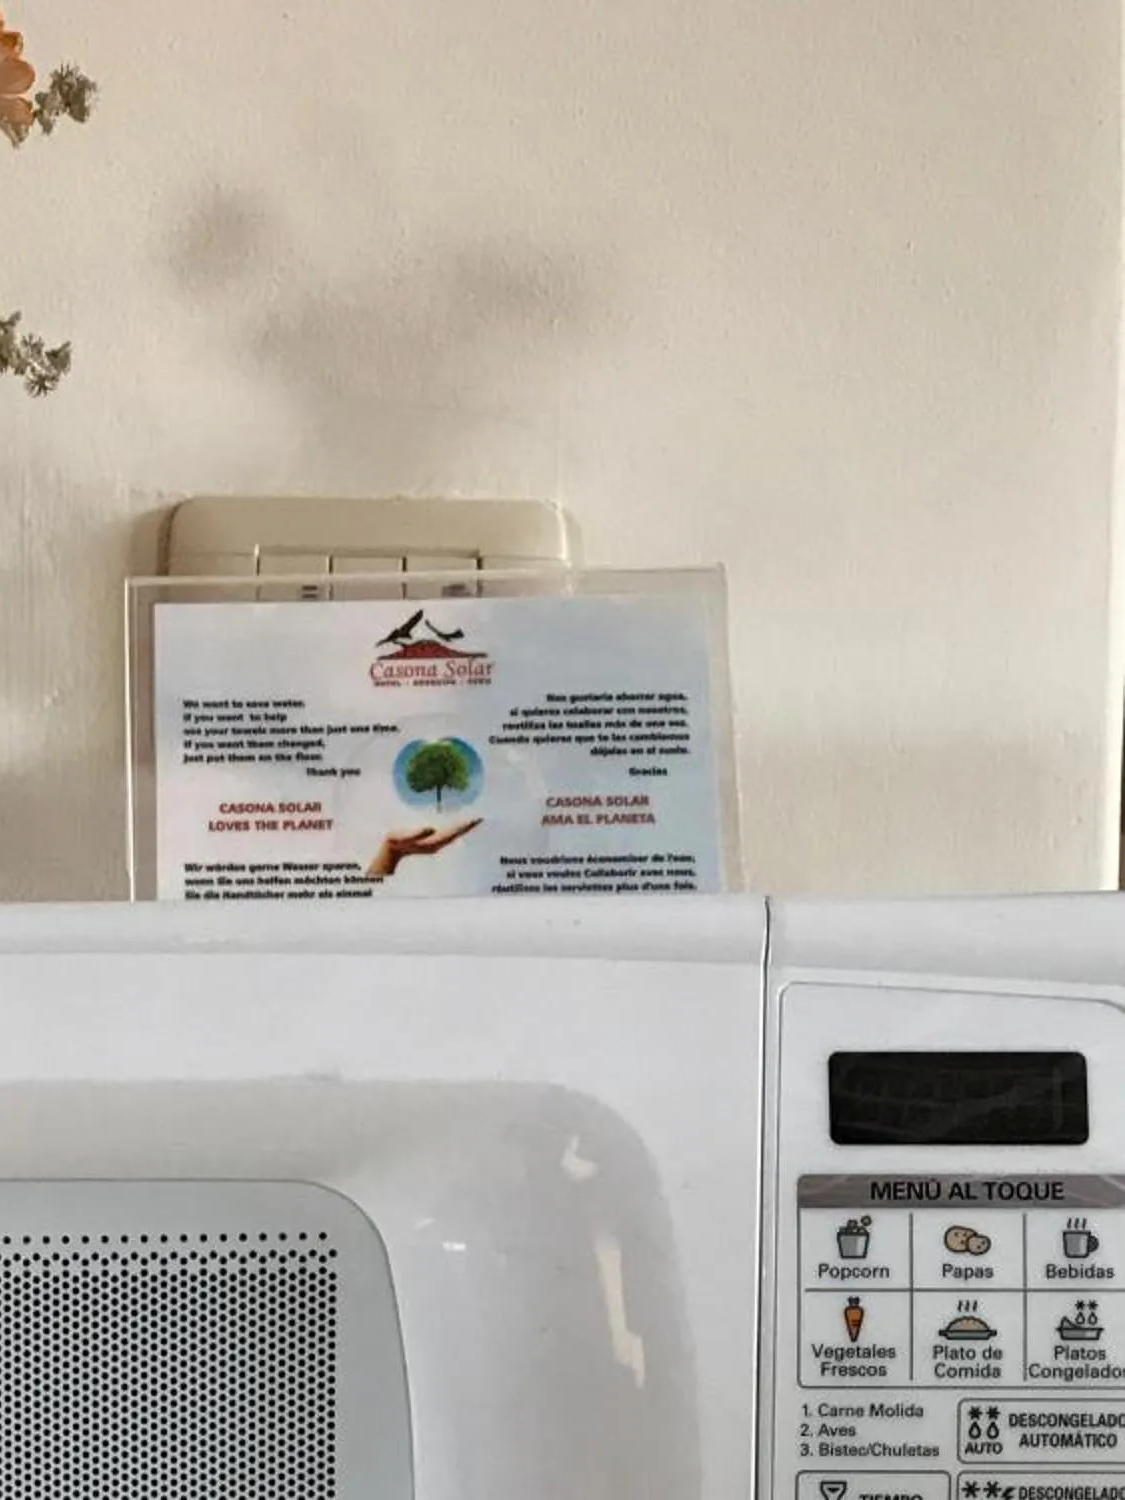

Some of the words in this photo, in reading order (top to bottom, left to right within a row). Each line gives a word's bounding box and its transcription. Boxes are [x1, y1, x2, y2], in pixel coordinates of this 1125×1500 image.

[370, 662, 437, 680] Casona
[444, 661, 492, 677] Solar
[219, 803, 273, 813] CASONA
[279, 803, 321, 813] SOLAR
[546, 797, 602, 808] CASONA
[607, 795, 649, 806] SOLAR
[209, 822, 249, 831] LOVES
[255, 821, 278, 830] THE
[283, 820, 333, 830] PLANET
[542, 815, 573, 825] AMA
[578, 814, 593, 824] EL
[597, 813, 655, 824] PLANETA
[949, 1183, 975, 1199] AL
[982, 1182, 1064, 1200] TOQUE
[818, 1264, 889, 1279] Popcorn
[943, 1264, 993, 1280] Papas
[1046, 1264, 1114, 1278] Bebidas
[812, 1343, 896, 1361] Vegetales
[933, 1345, 975, 1360] Plato
[982, 1345, 1003, 1360] de
[1055, 1345, 1106, 1361] Platos
[821, 1363, 887, 1376] Frescos
[934, 1364, 1001, 1378] Comida
[1029, 1364, 1125, 1382] Congelado
[818, 1403, 864, 1417] Carne
[869, 1403, 924, 1417] Molida
[818, 1424, 856, 1436] Aves
[1019, 1431, 1118, 1448] AUTOMÁTICO
[819, 1442, 939, 1456] Bistec/Chuletas
[965, 1442, 1003, 1454] AUTO
